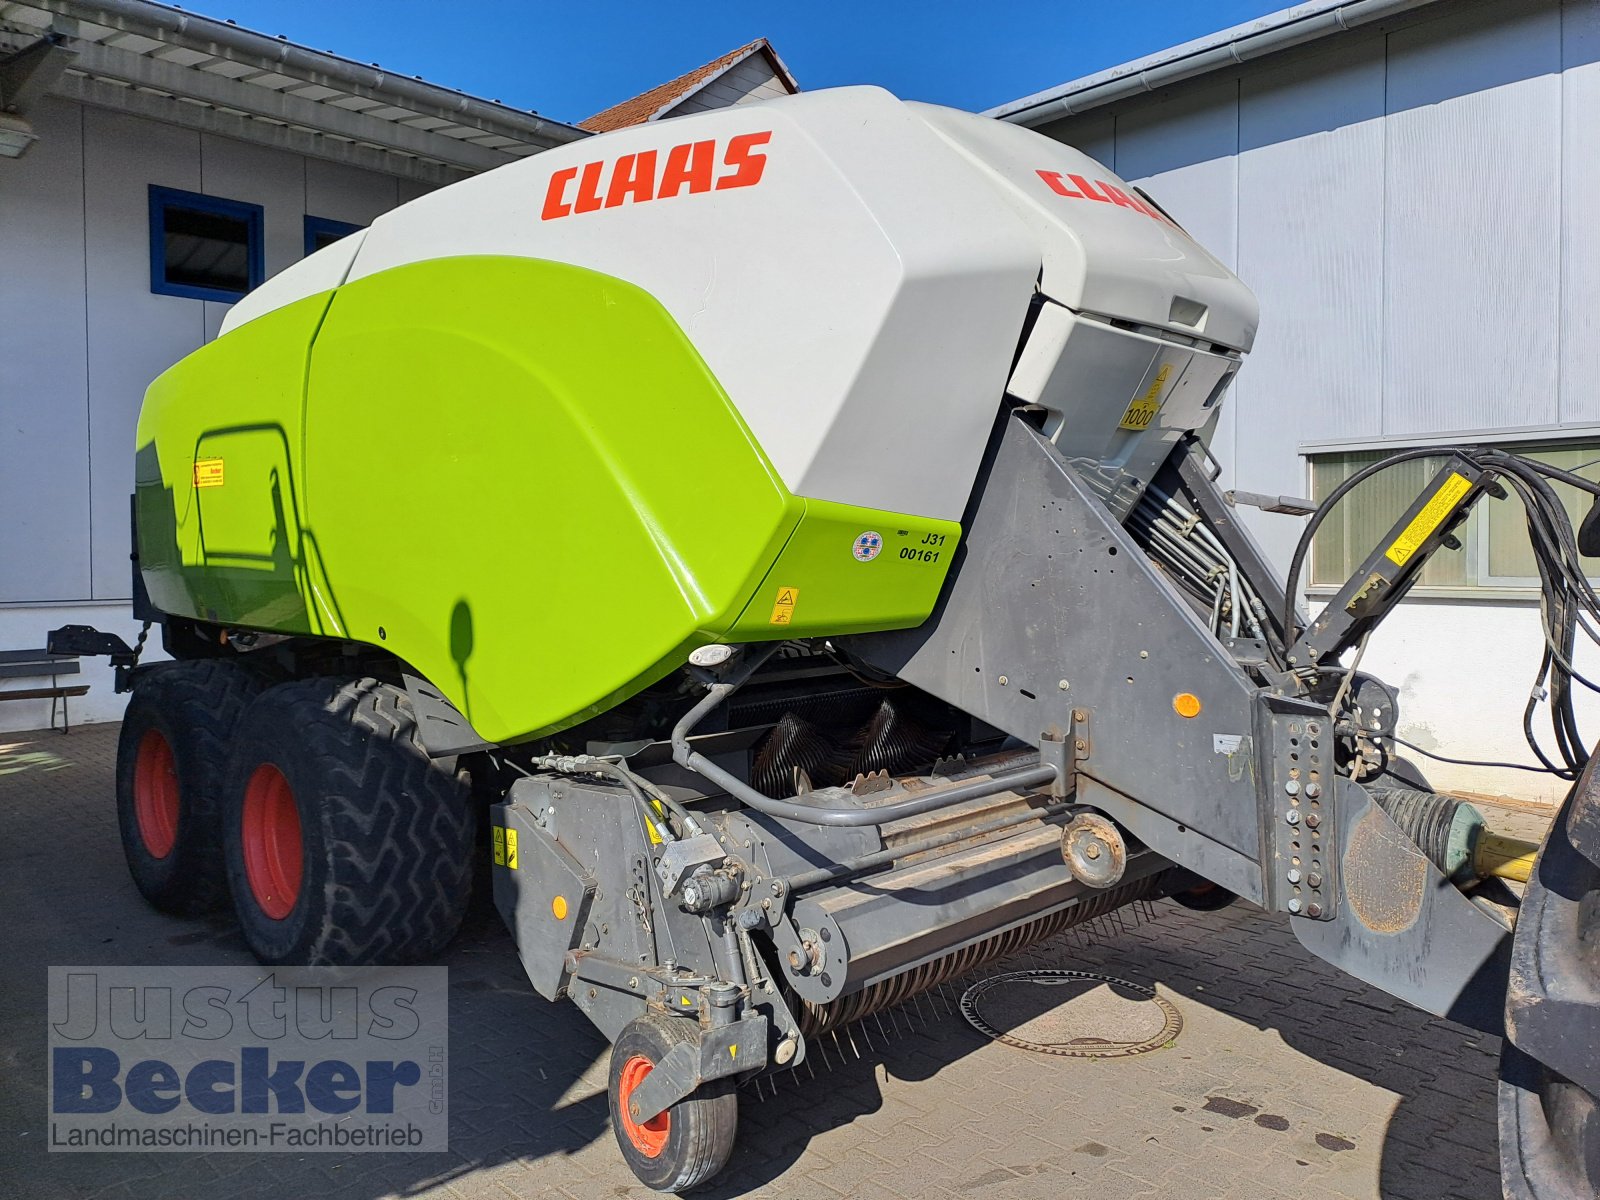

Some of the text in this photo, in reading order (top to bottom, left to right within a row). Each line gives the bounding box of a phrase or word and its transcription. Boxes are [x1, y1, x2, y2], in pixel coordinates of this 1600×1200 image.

[541, 130, 773, 221] CLAAS
[1124, 407, 1154, 426] 1000
[921, 533, 946, 547] J31
[899, 547, 940, 563] 00161
